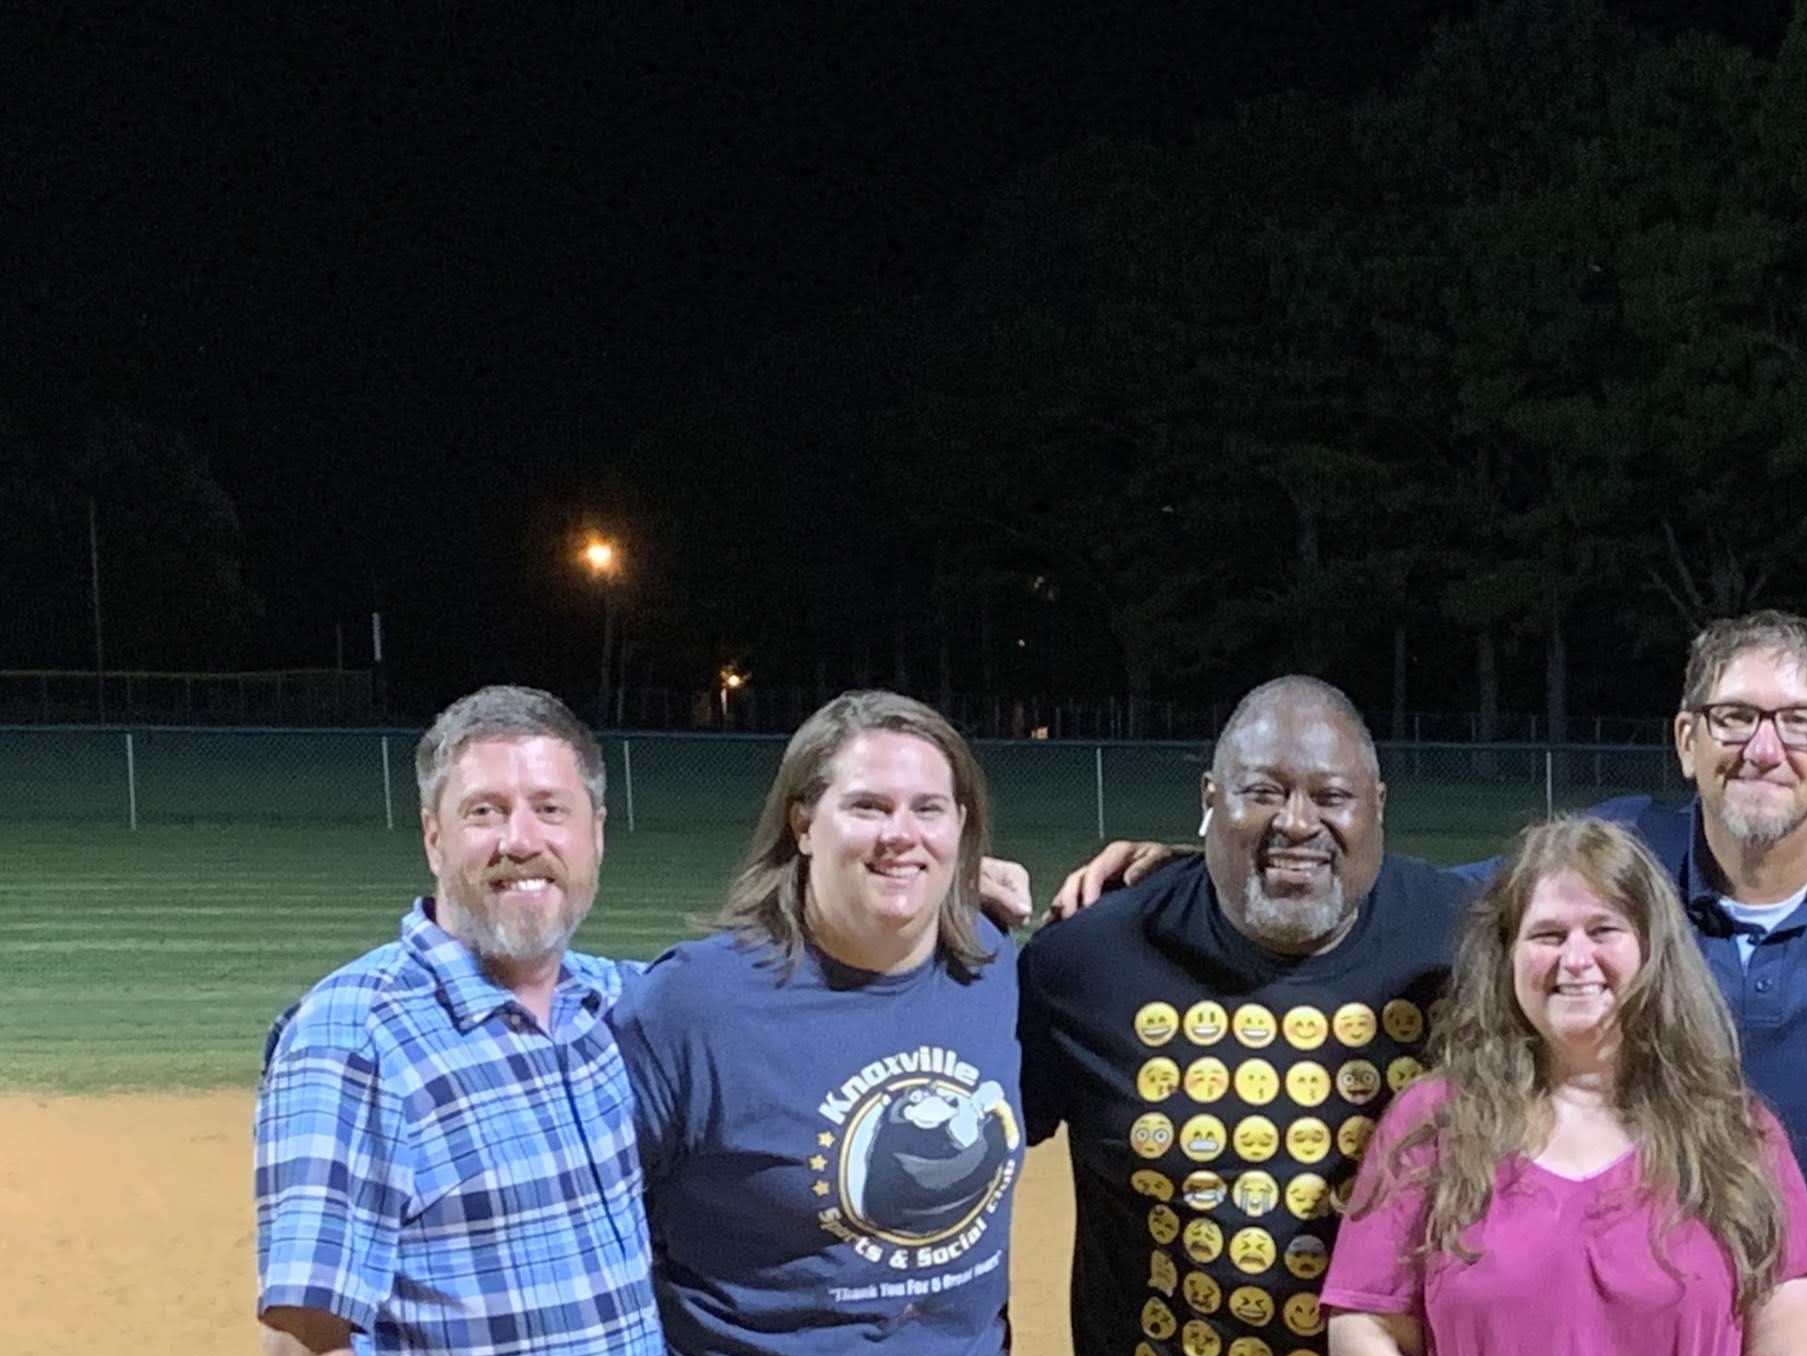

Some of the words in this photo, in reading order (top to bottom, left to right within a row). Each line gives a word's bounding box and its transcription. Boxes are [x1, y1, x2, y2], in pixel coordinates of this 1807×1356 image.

[818, 1046, 980, 1125] Knoxville
[818, 1207, 884, 1263] Sports
[889, 1250, 909, 1269] &
[916, 1216, 988, 1268] Social
[880, 1282, 905, 1298] You
[906, 1279, 929, 1296] For
